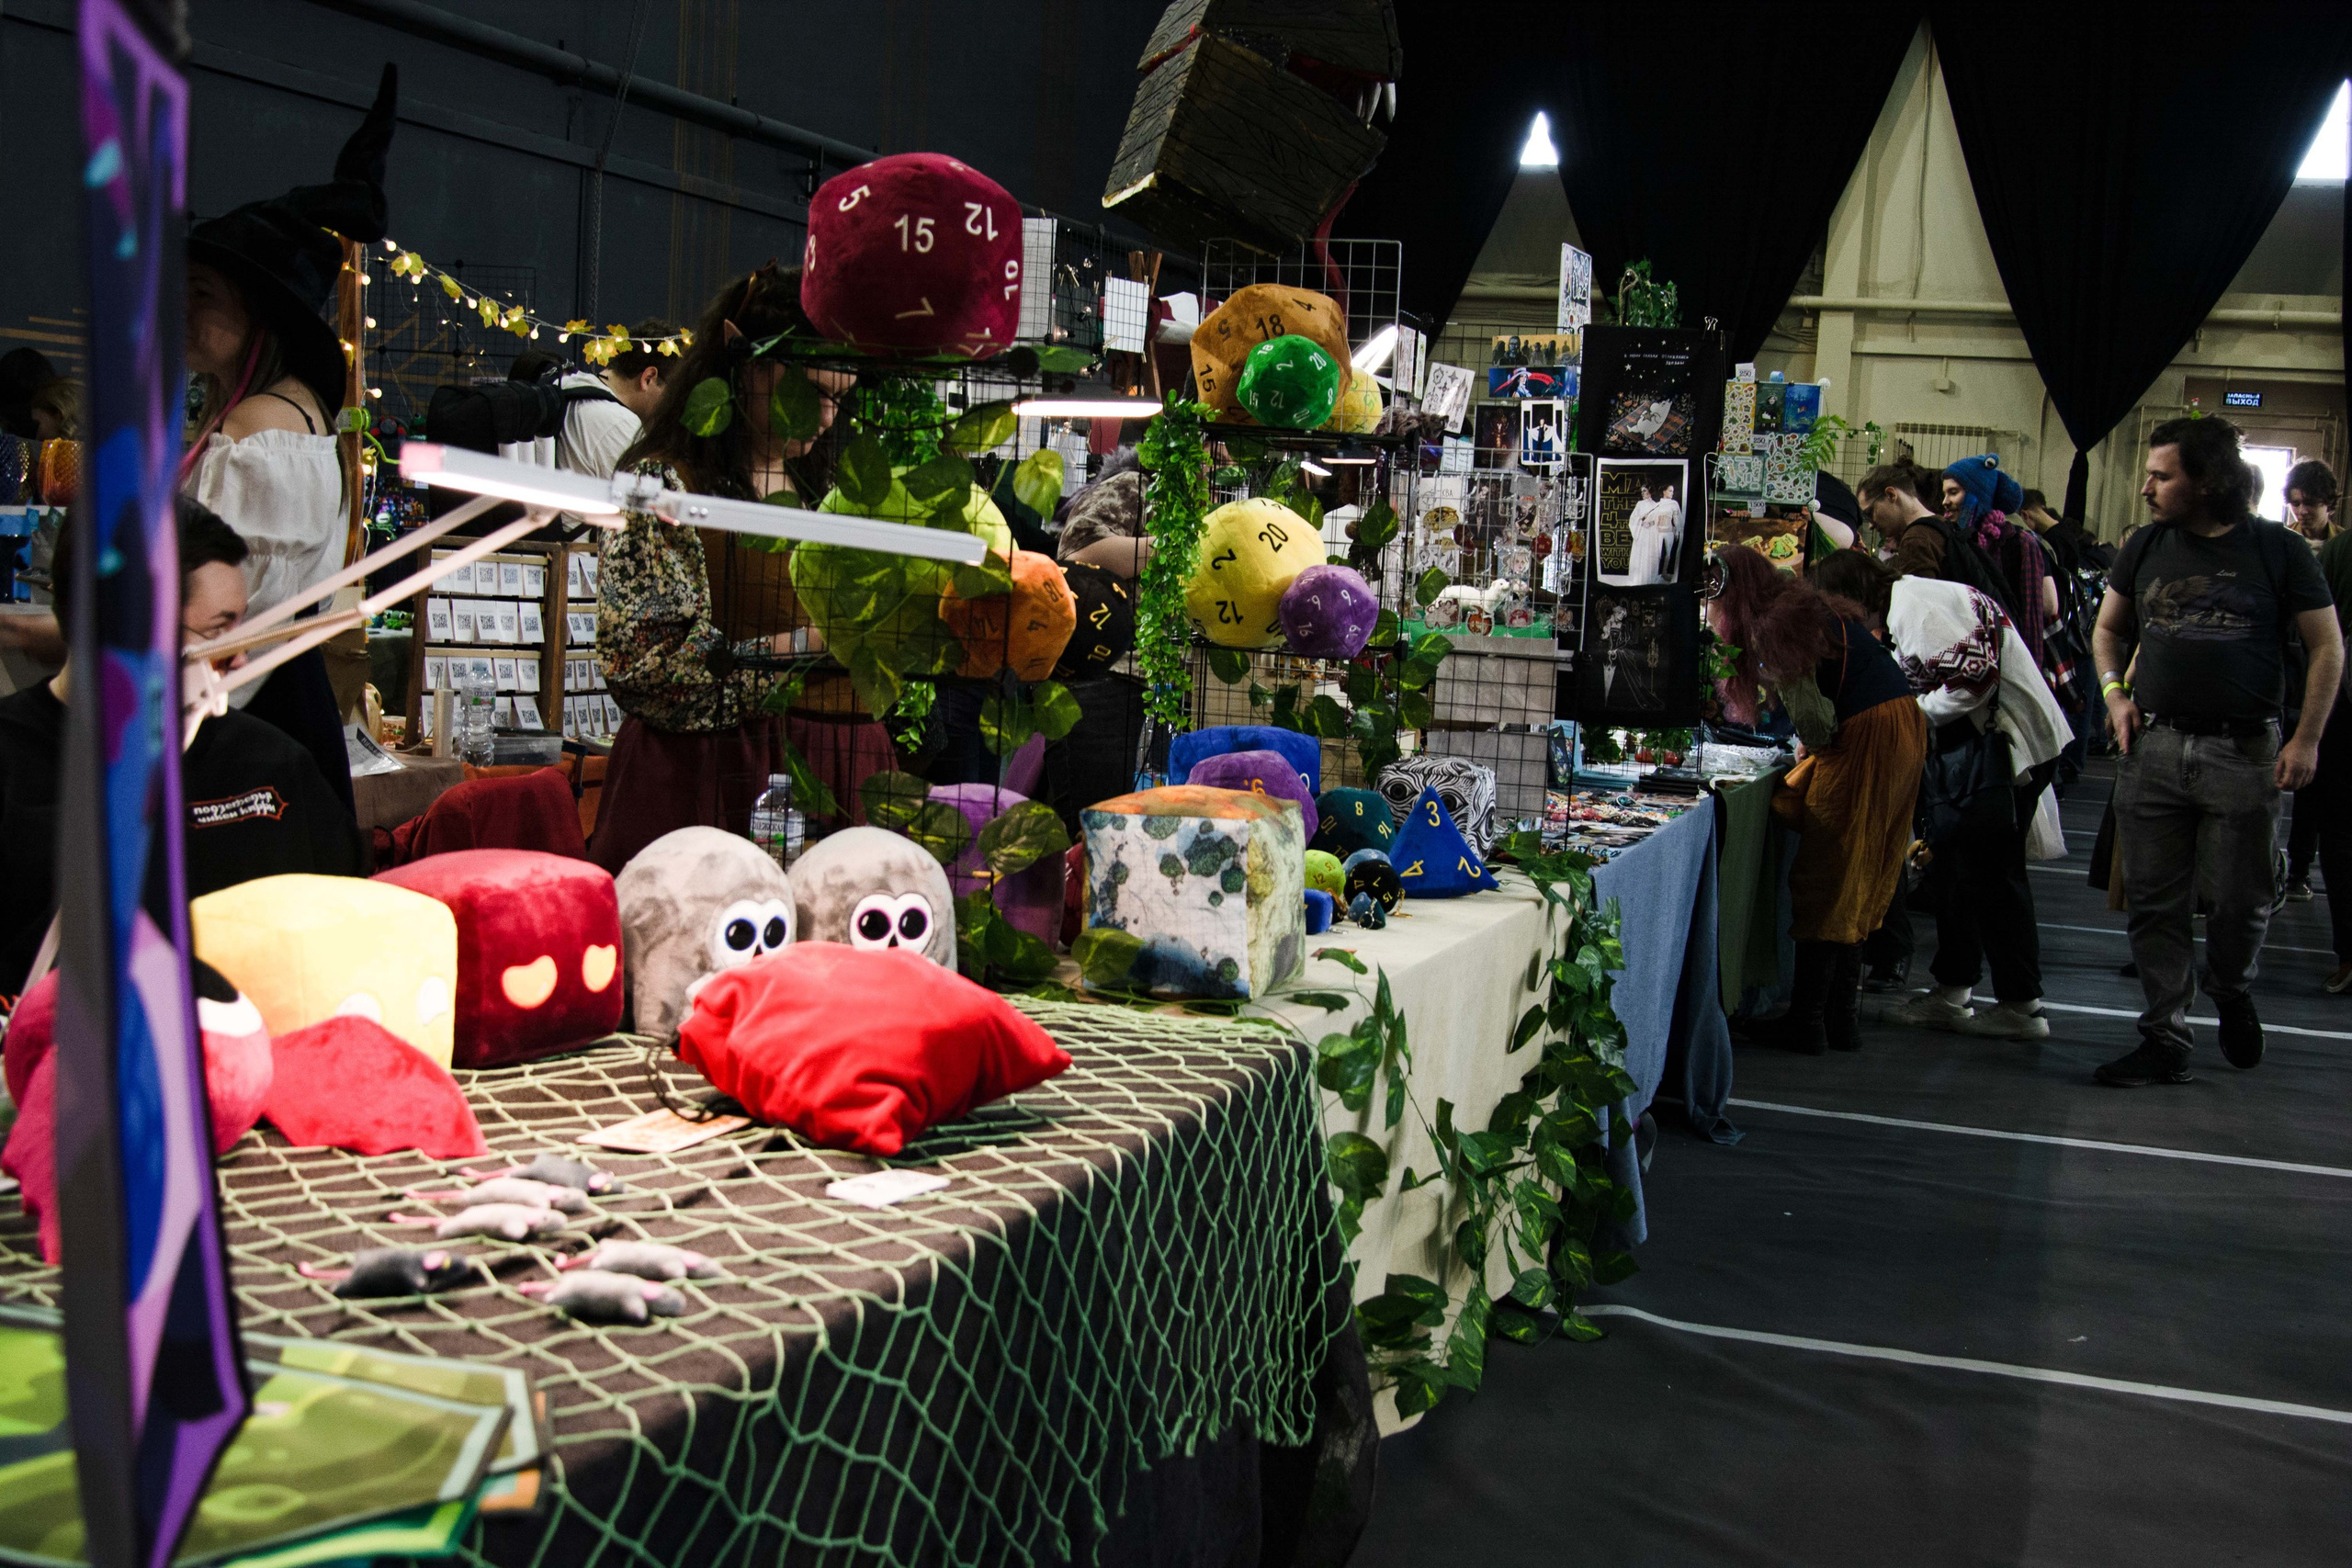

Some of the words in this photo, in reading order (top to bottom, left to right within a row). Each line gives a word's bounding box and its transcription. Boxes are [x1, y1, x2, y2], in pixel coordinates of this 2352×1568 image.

[837, 185, 871, 212] 5
[965, 201, 999, 242] 12
[894, 214, 935, 254] 15
[1004, 260, 1019, 300] 10
[1292, 298, 1317, 312] 4
[1217, 318, 1231, 342] 5
[1256, 313, 1285, 341] 18
[1257, 344, 1274, 356] 18
[1276, 360, 1295, 371] 2
[1308, 352, 1327, 371] 20
[1200, 364, 1217, 393] 15
[1271, 389, 1284, 409] 12
[1327, 388, 1333, 404] 8
[2225, 398, 2259, 407] ВЫХОД
[1600, 471, 1650, 494] MA
[1259, 523, 1288, 552] 20
[1600, 529, 1633, 547] BE
[1212, 548, 1237, 570] 2
[1043, 578, 1063, 603] 18
[1090, 603, 1113, 631] 12
[1216, 600, 1244, 626] 12
[1088, 644, 1112, 662] 10
[1354, 801, 1364, 817] 8
[1426, 801, 1442, 828] 3
[1320, 815, 1338, 835] 10
[1378, 820, 1392, 840] 16
[1400, 859, 1424, 878] 4
[1457, 856, 1481, 879] 2
[1313, 873, 1327, 886] 12
[1383, 891, 1394, 903] 15
